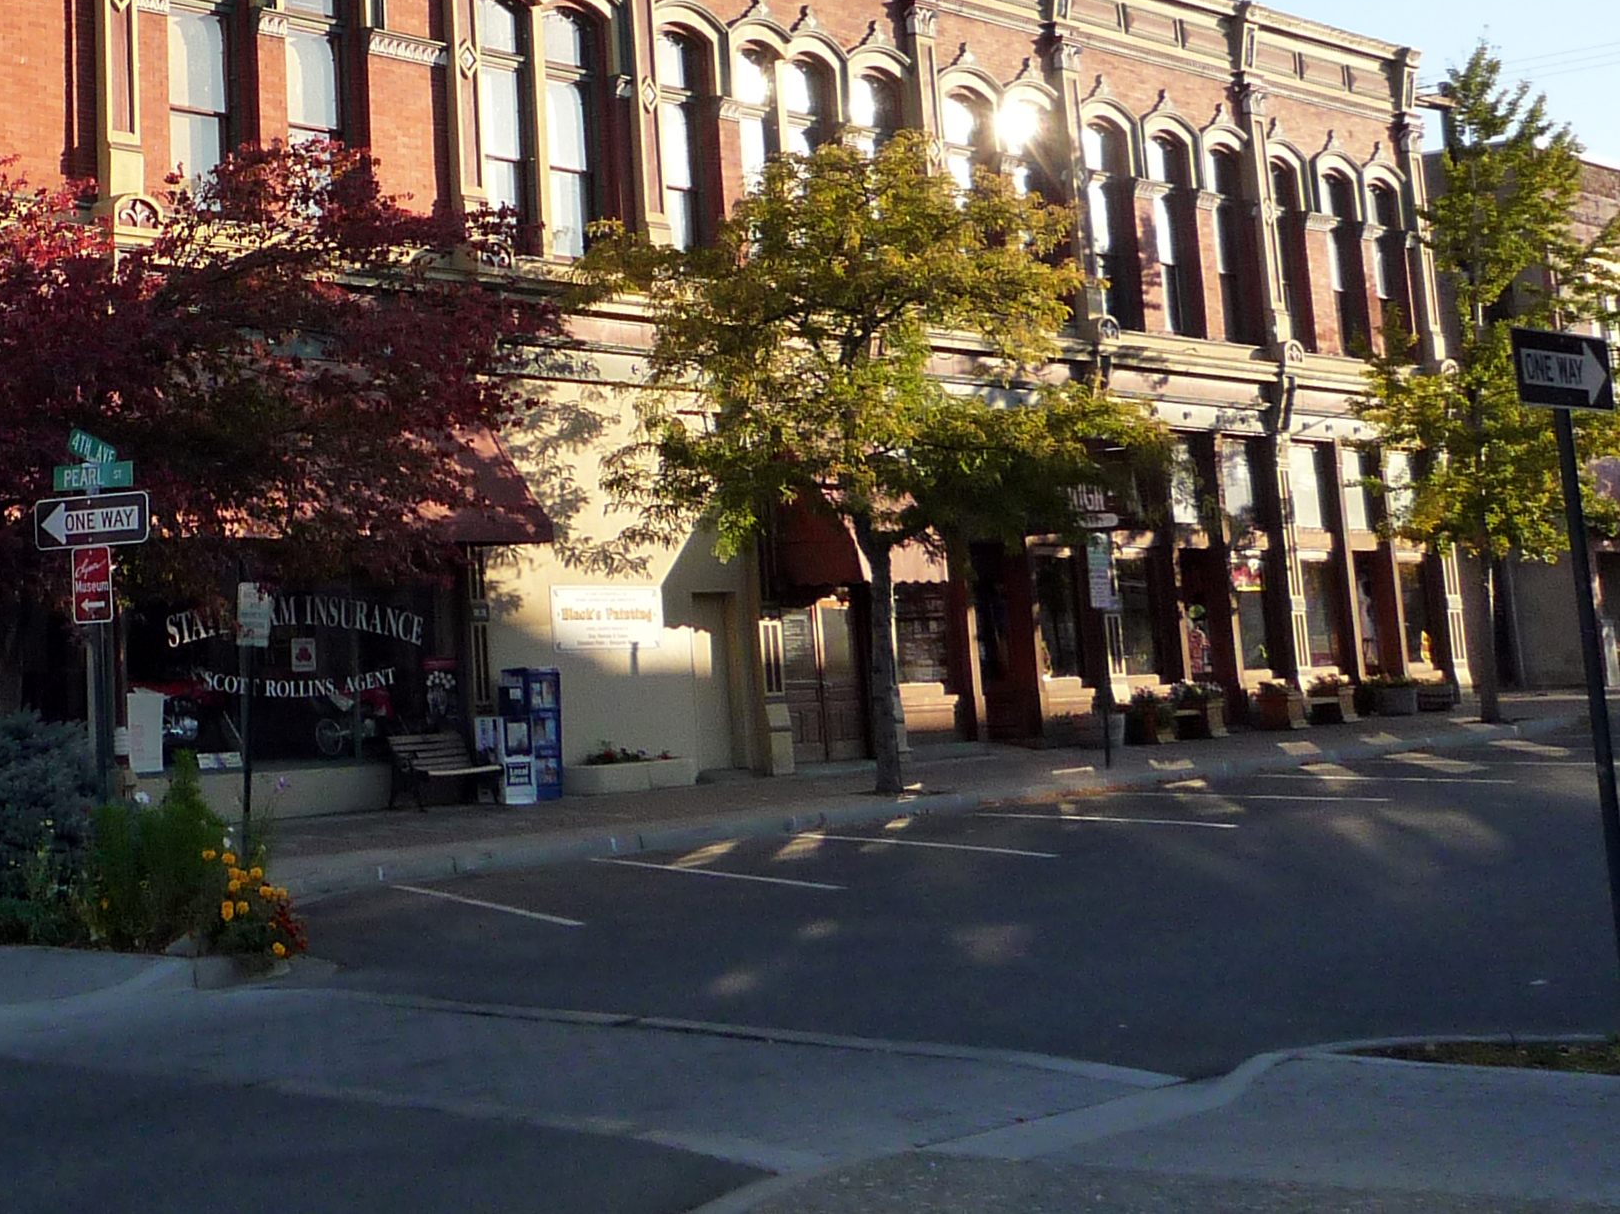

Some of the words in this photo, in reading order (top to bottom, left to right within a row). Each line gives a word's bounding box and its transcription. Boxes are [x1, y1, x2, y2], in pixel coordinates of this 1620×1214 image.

[1524, 353, 1553, 382] ONE
[1557, 355, 1582, 384] WAY
[71, 433, 91, 460] 4TH
[96, 446, 115, 462] AVE
[63, 468, 104, 487] PEARL
[112, 469, 121, 478] ST
[65, 512, 95, 531] ONE
[101, 508, 134, 528] WAY
[75, 579, 108, 593] Museum
[305, 594, 422, 646] INSURANCE
[561, 608, 601, 620] Black's
[606, 608, 651, 622] Painting
[264, 676, 338, 698] ROLLINS,
[344, 667, 395, 693] AGENT
